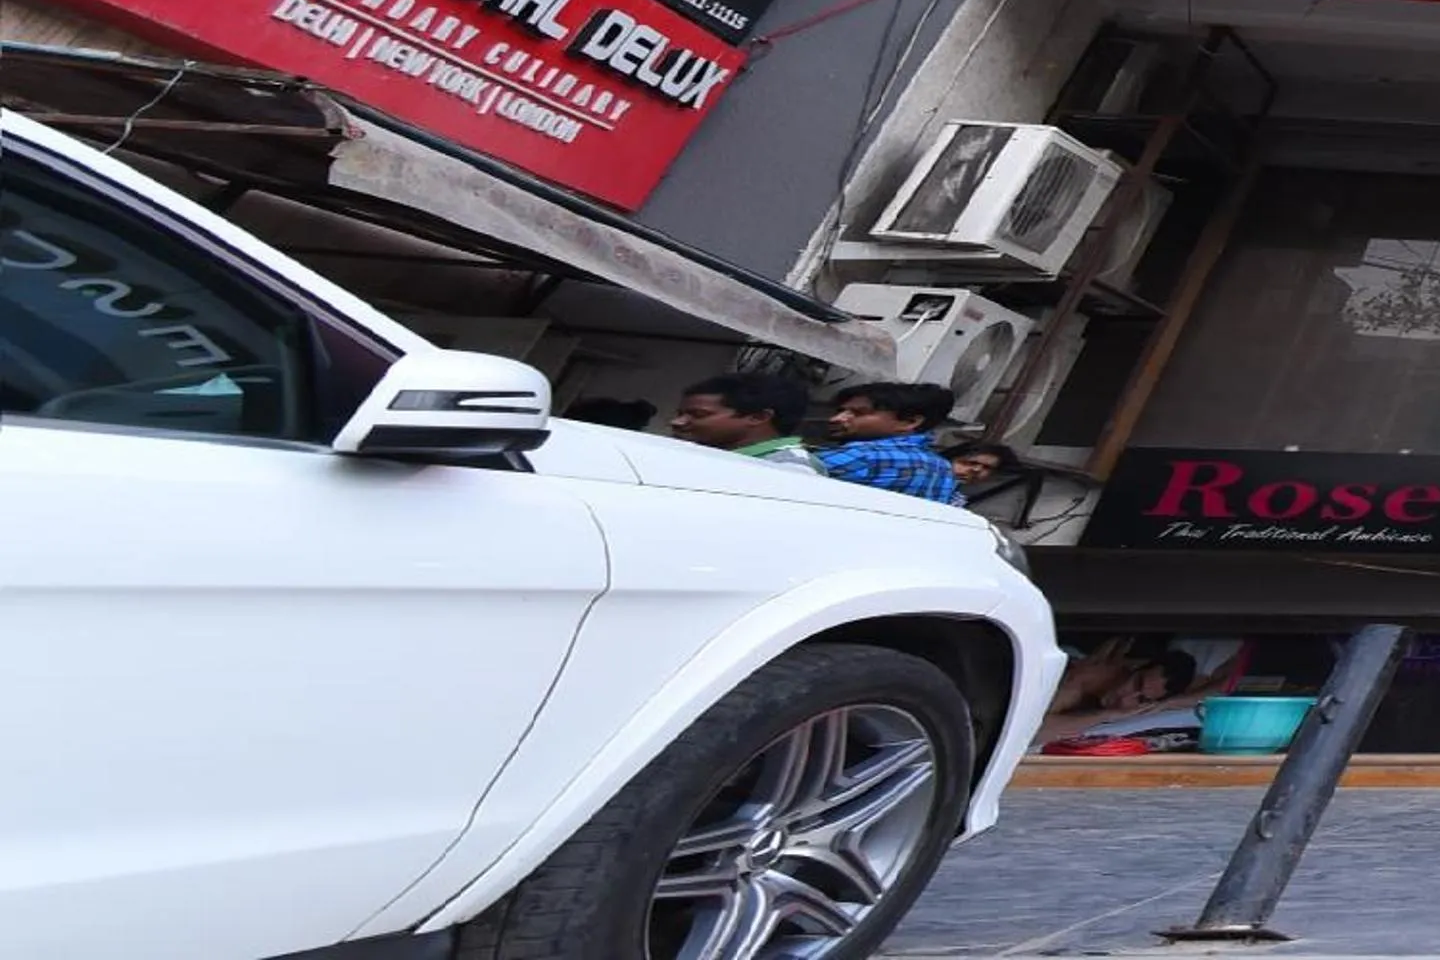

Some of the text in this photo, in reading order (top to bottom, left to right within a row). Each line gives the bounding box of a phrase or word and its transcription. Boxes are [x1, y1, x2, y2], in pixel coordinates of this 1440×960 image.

[366, 35, 433, 77] NEW
[426, 58, 493, 106] YORK
[495, 91, 585, 144] LONDON
[483, 42, 633, 121] CULINARY
[581, 8, 730, 110] DELUX
[1220, 523, 1334, 541] Traditional
[1337, 526, 1433, 542] Ambience
